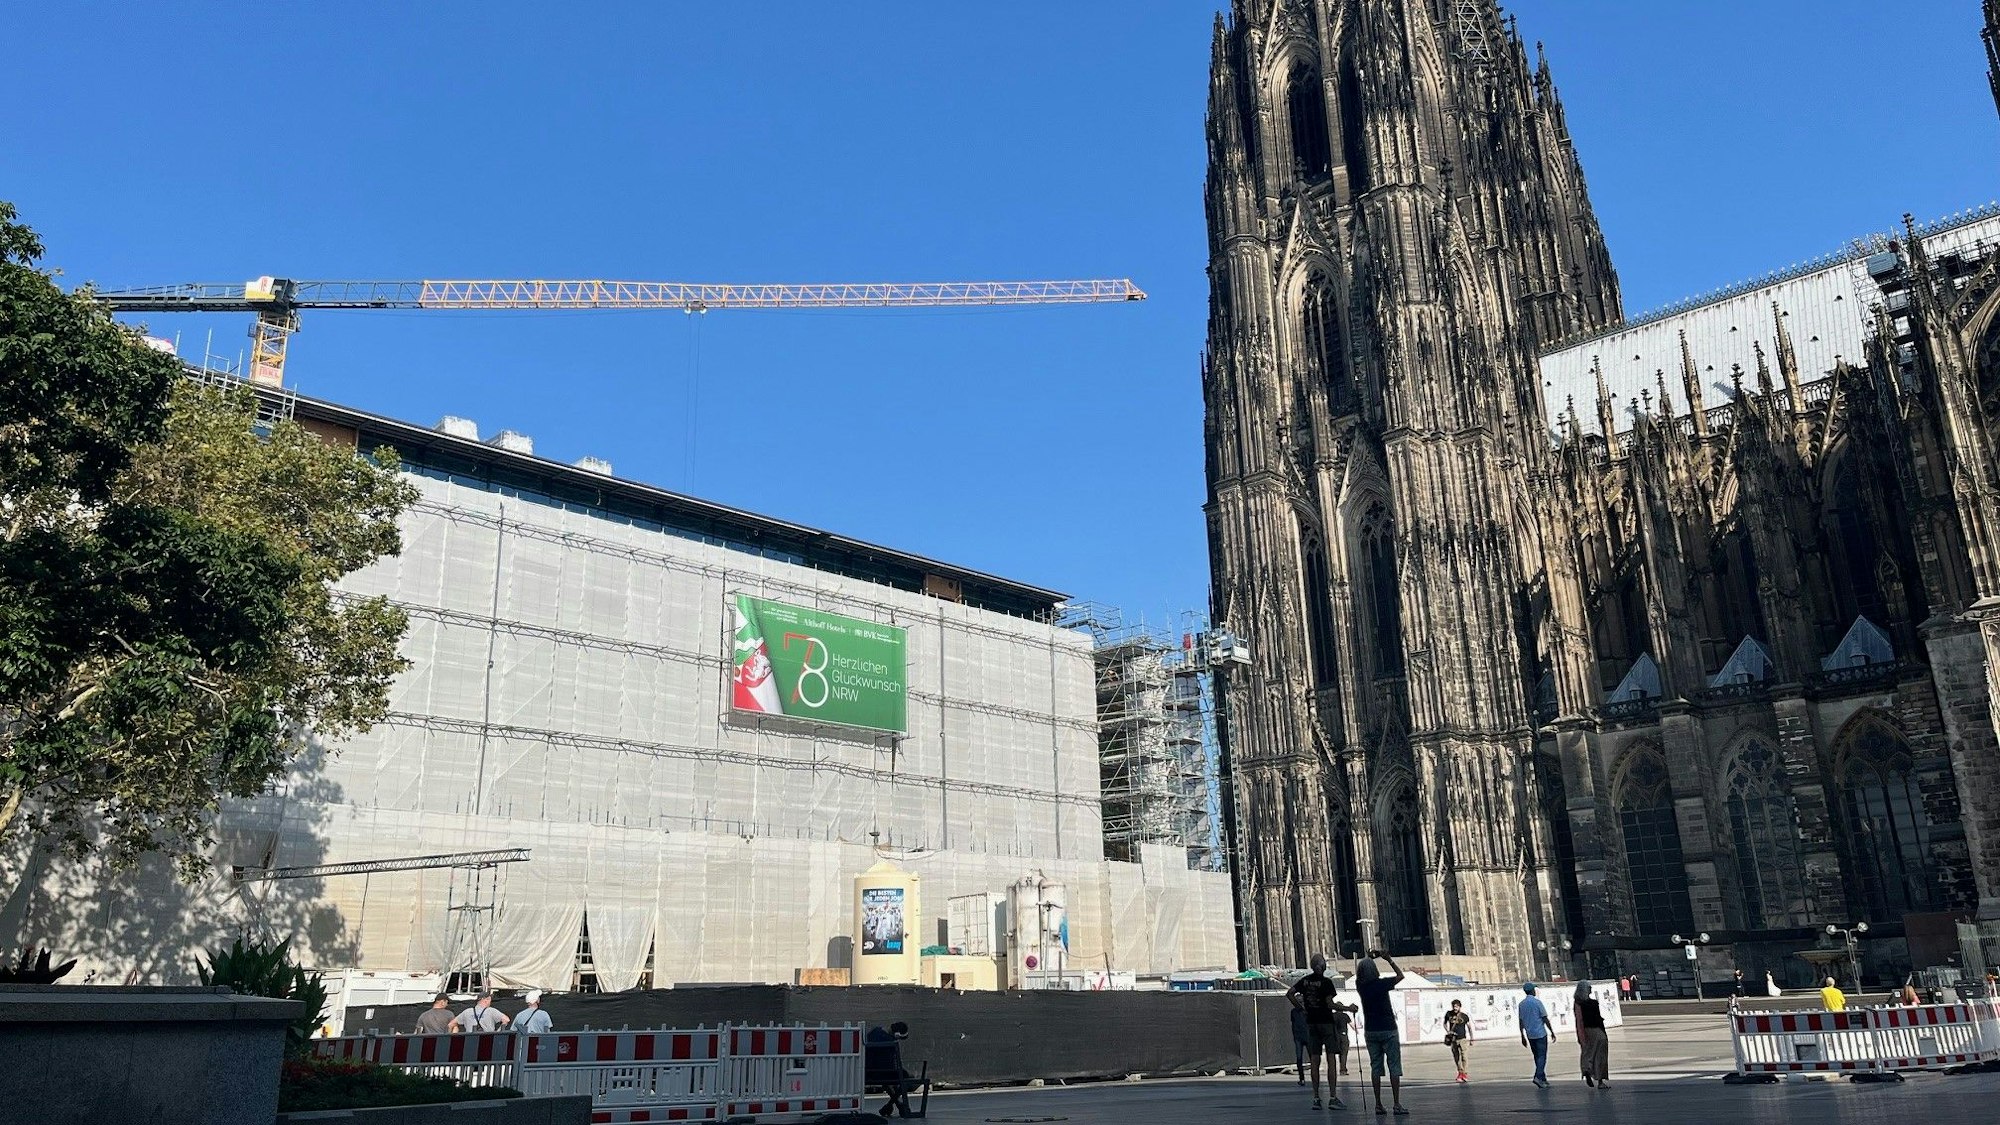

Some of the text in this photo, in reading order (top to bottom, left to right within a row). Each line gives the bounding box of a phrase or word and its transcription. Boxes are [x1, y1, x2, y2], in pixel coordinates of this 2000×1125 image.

[826, 622, 846, 634] Hotels
[832, 653, 888, 675] Herzlichen
[831, 669, 901, 693] Glückwunsch
[832, 685, 859, 702] NRW
